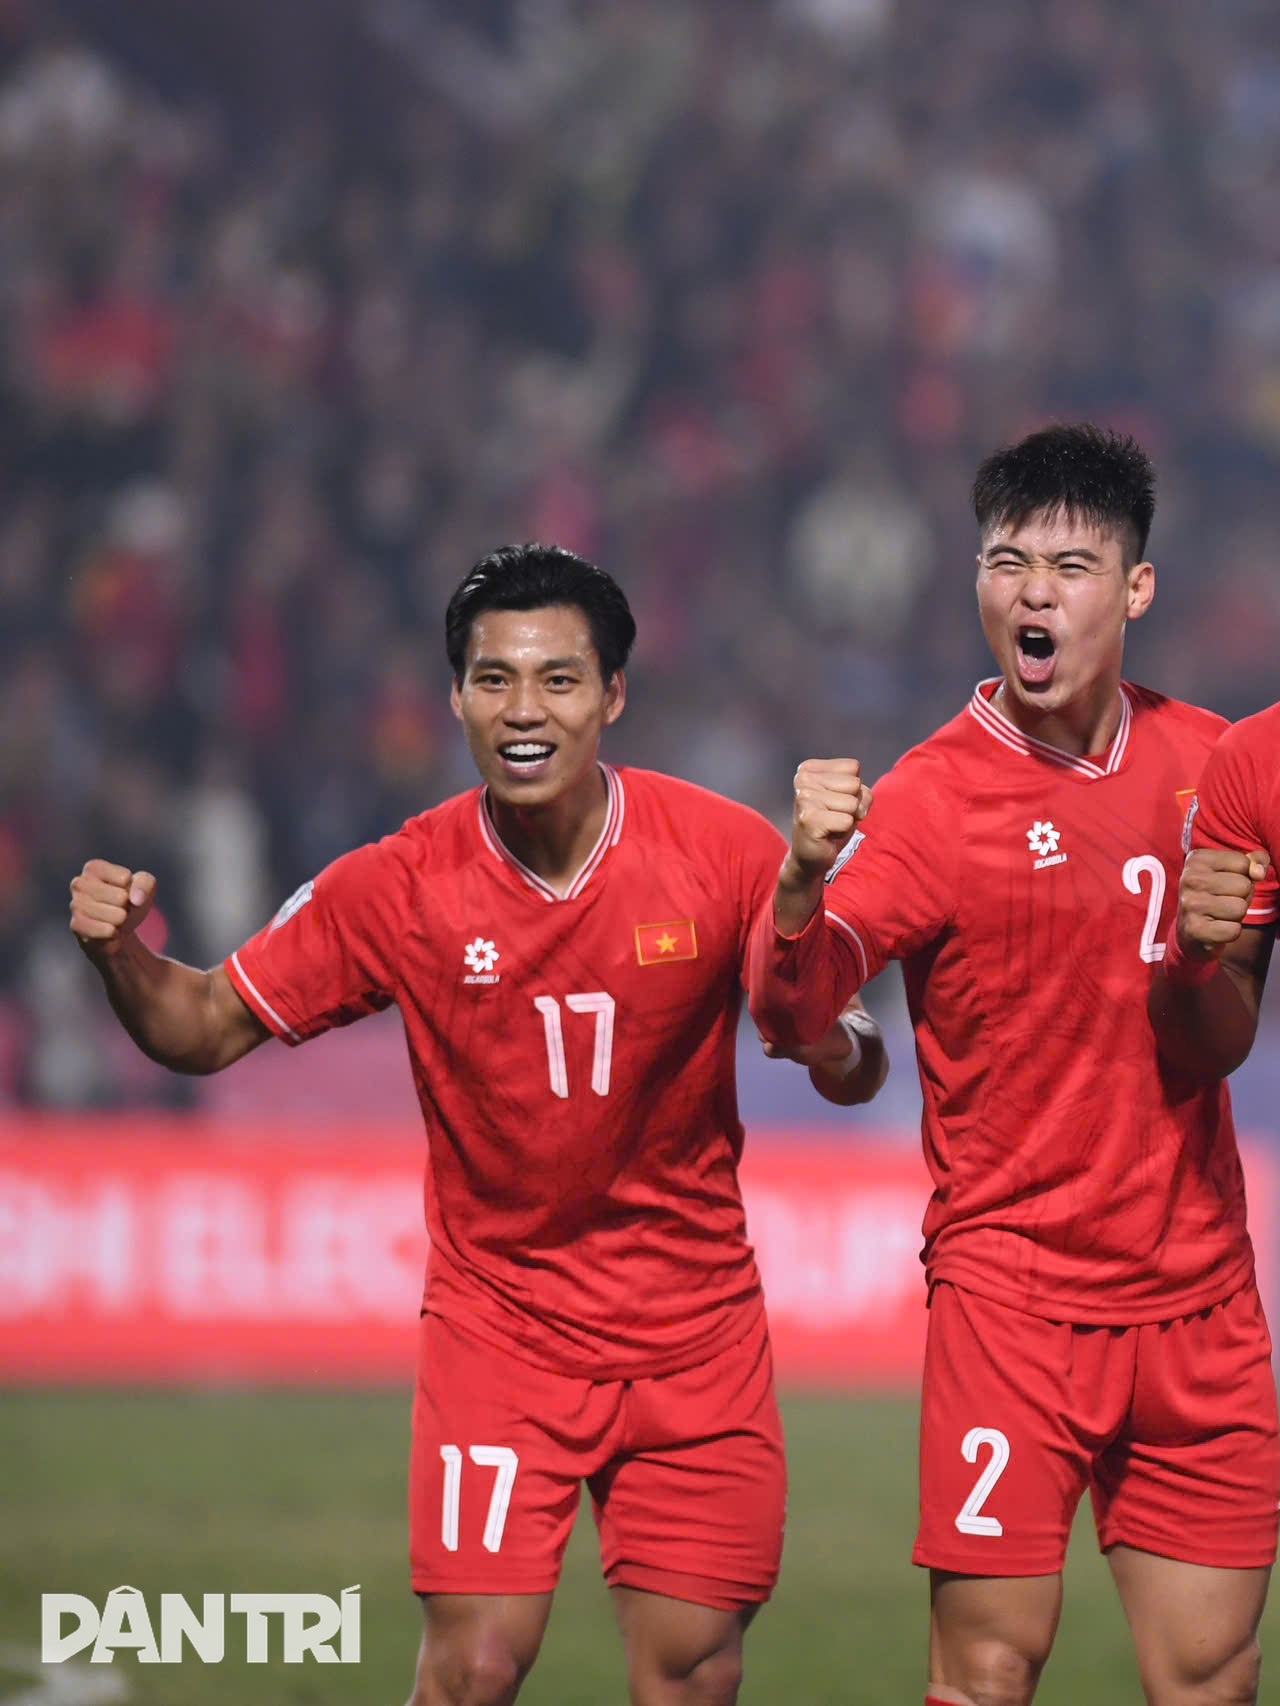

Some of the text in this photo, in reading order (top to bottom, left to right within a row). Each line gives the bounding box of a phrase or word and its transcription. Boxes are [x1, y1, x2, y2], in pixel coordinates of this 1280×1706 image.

[1122, 854, 1167, 963] 2
[534, 991, 616, 1098] 17
[440, 1444, 519, 1553] 17
[955, 1427, 1011, 1537] 2
